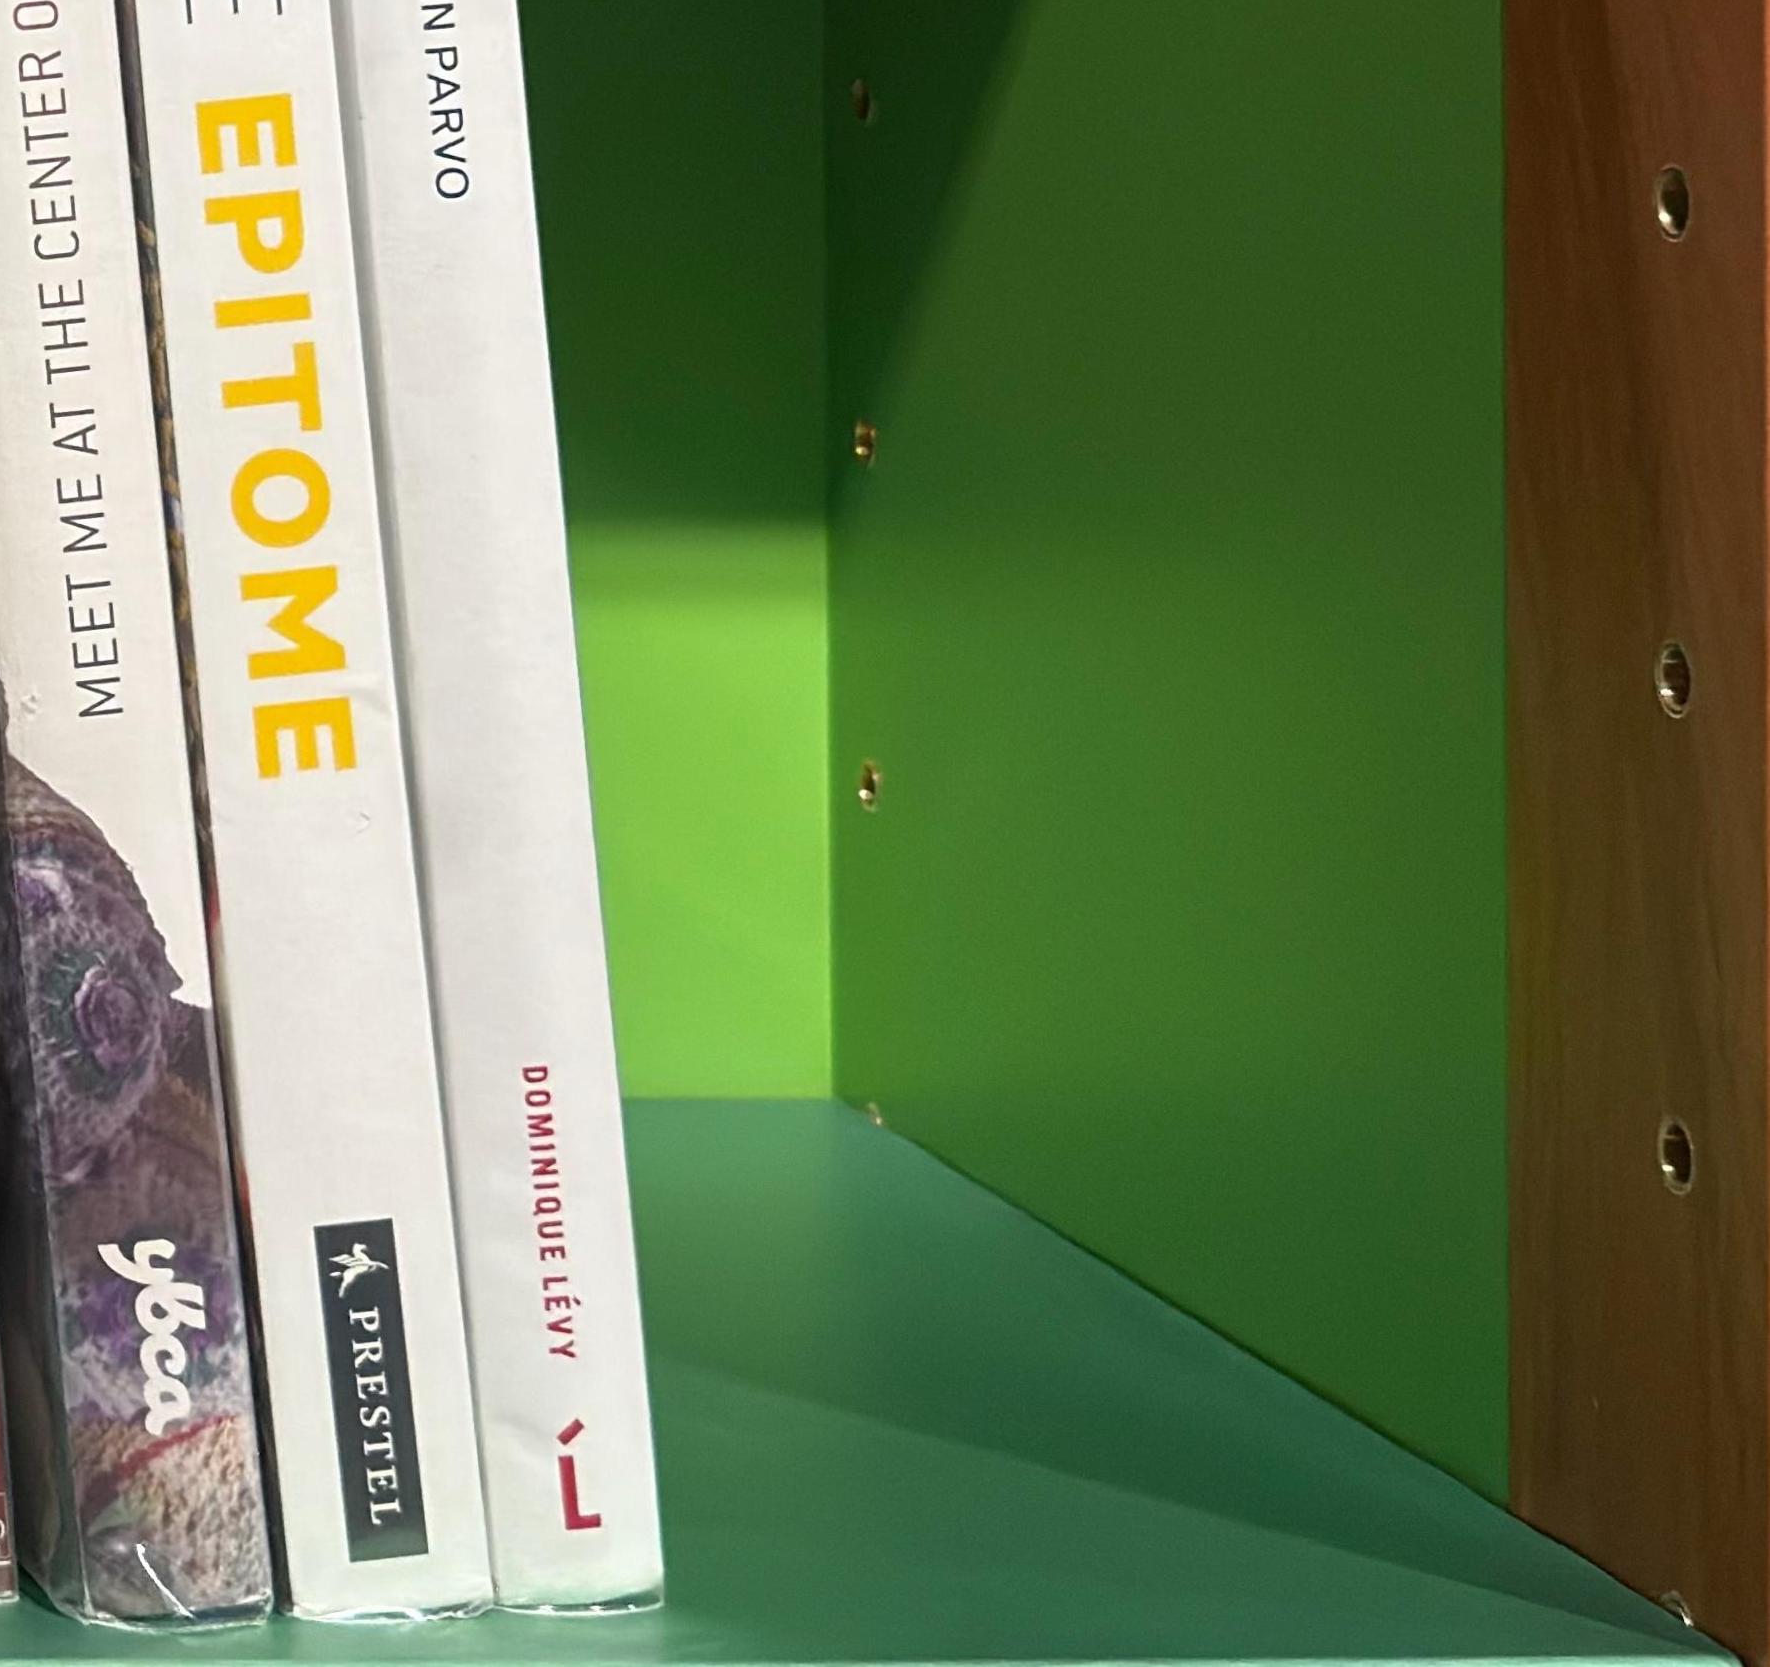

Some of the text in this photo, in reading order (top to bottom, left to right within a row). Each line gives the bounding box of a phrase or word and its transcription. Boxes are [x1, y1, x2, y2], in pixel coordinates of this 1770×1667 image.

[19, 49, 81, 261] CENTER
[425, 47, 469, 200] PARVO
[40, 279, 92, 386] THE
[49, 402, 100, 456] AT
[57, 474, 108, 554] ME
[195, 93, 357, 779] EPITOME
[66, 573, 125, 719] MEET
[522, 1066, 582, 1360] DOMINIQUE LÉVY
[98, 1238, 206, 1437] ybca
[348, 1305, 400, 1527] PRESTEL
